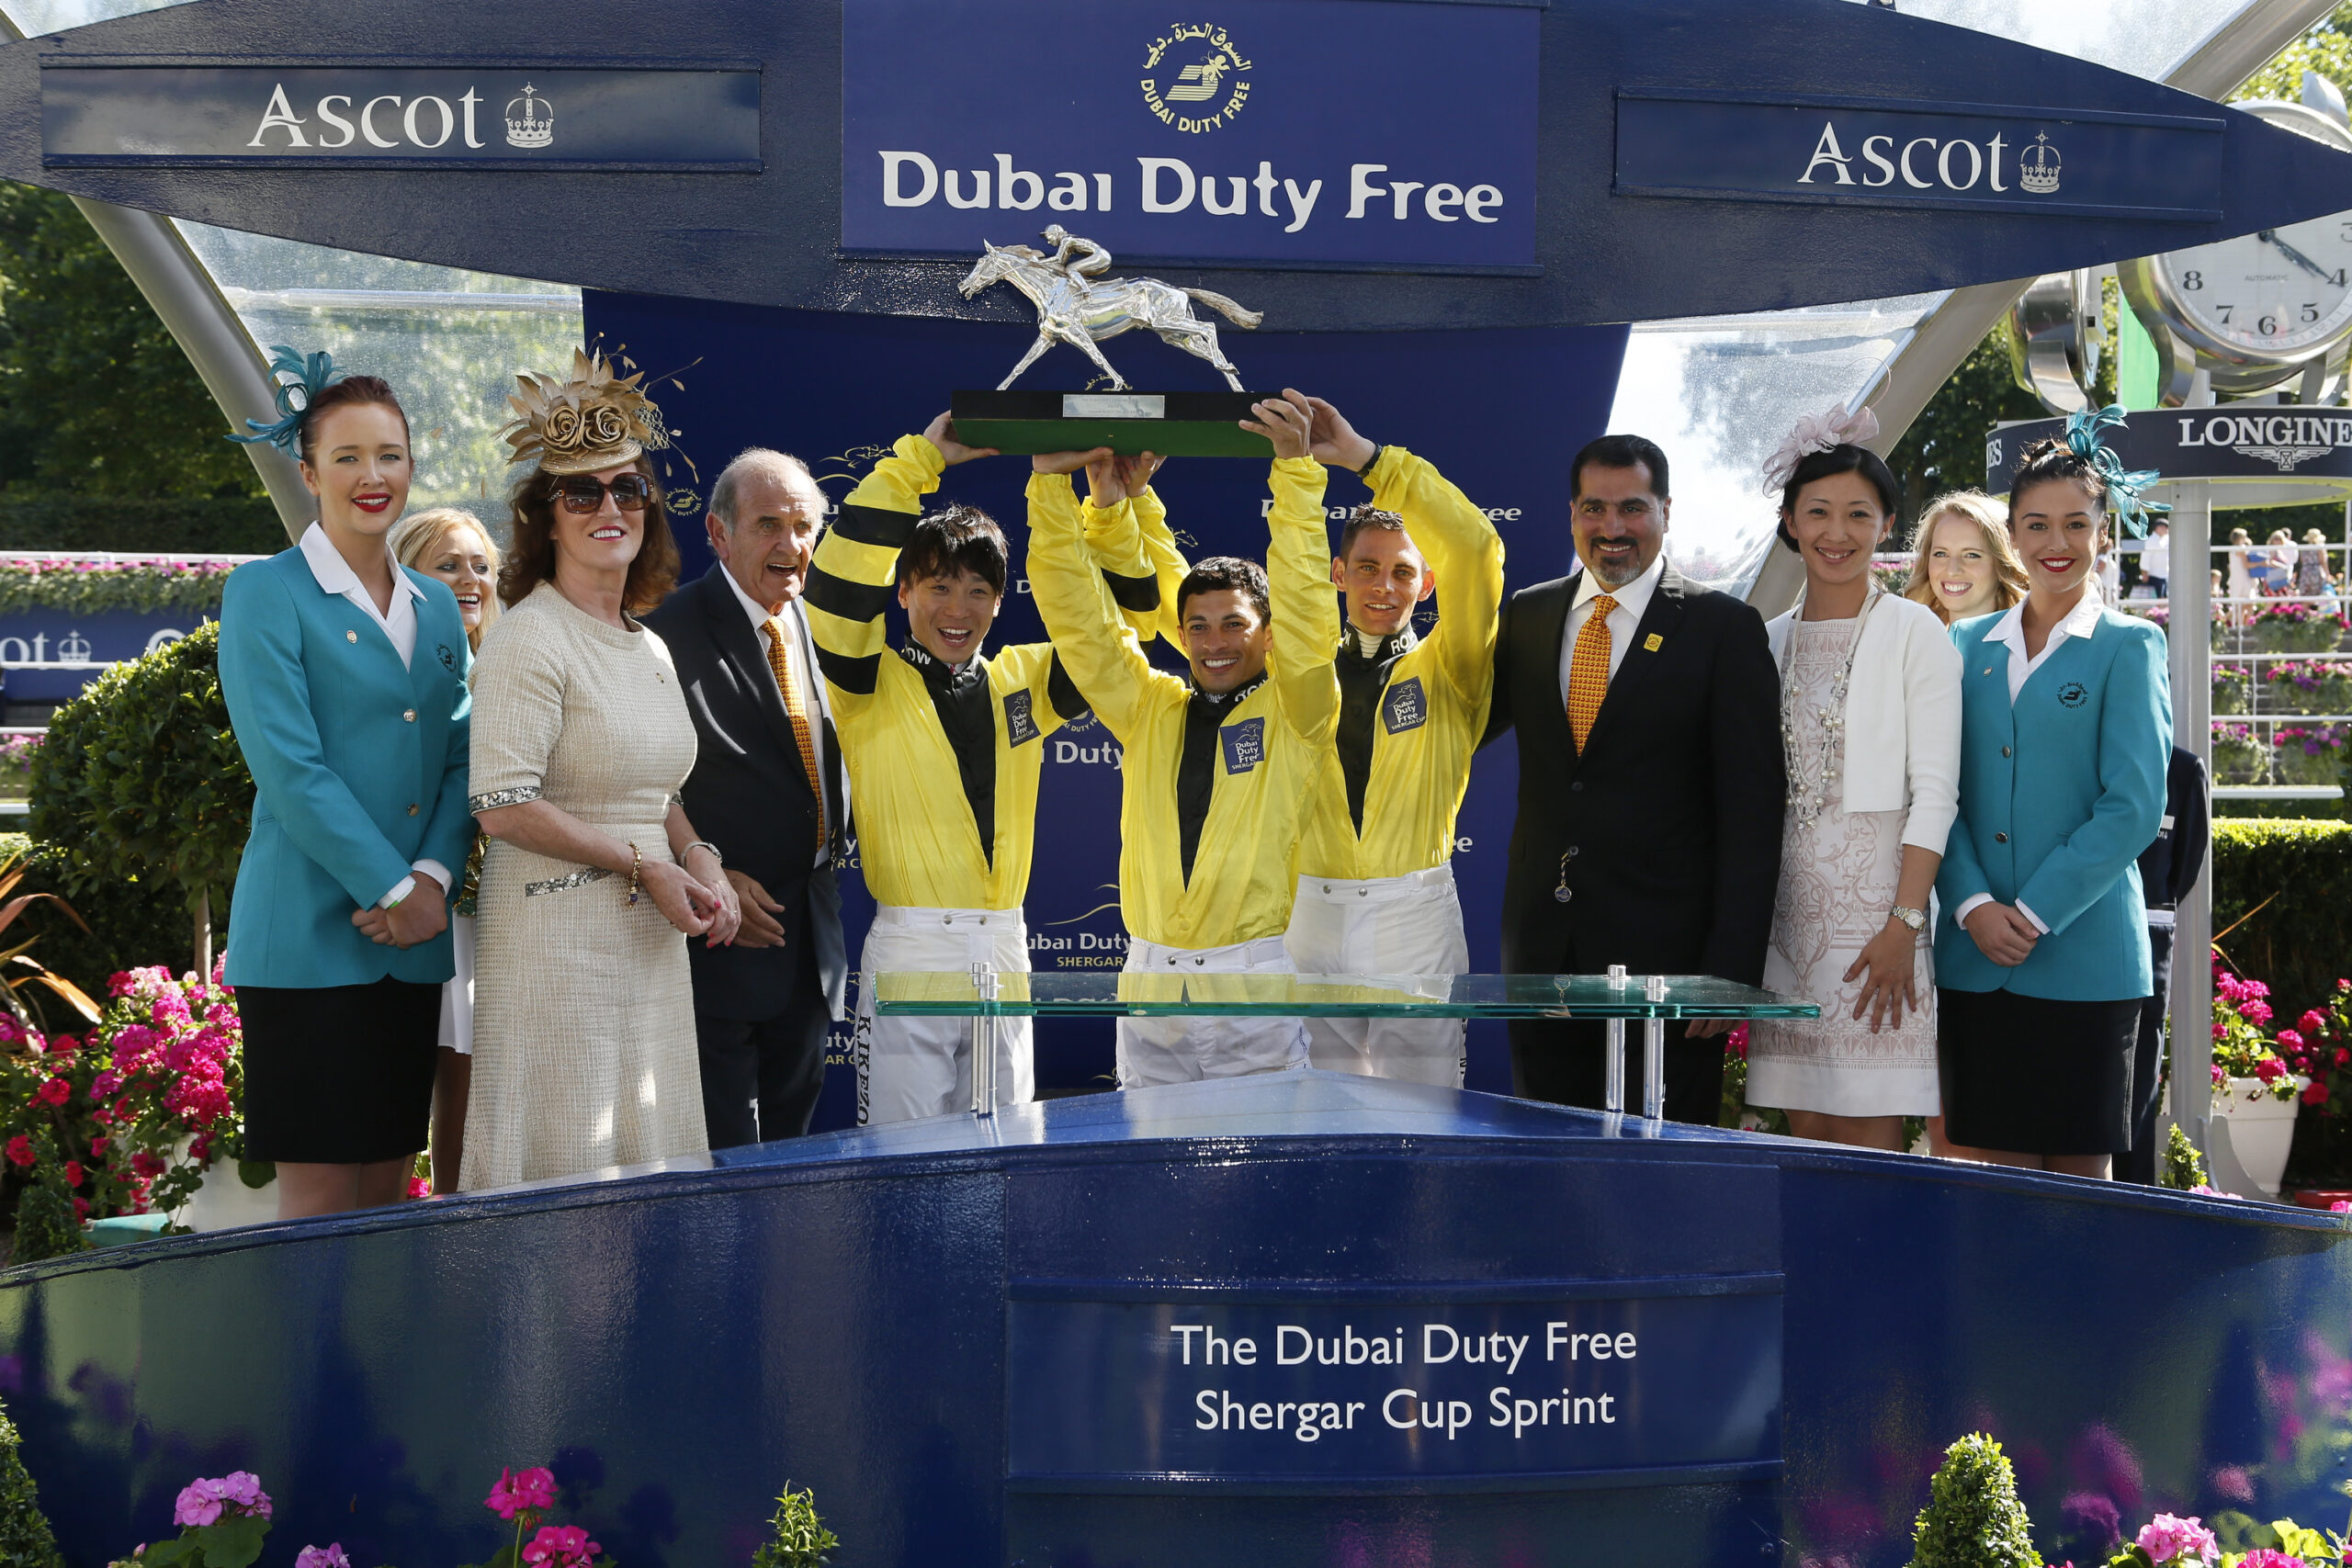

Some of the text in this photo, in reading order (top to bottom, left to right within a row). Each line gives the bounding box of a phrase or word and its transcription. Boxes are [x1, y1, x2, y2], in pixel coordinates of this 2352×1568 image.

[246, 84, 486, 149] Ascot
[1140, 79, 1250, 134] DUBAI DUTY FREE
[1797, 121, 2008, 192] Ascot
[878, 151, 1504, 233] Dubai Duty Free
[2183, 271, 2203, 290] 8
[2216, 305, 2234, 324] 7
[2301, 302, 2320, 322] 5
[2257, 316, 2277, 336] 6
[2179, 417, 2352, 446] LONGINE
[1395, 705, 1416, 717] Duty
[1396, 713, 1418, 724] Free
[1070, 724, 1090, 732] DUTY
[1055, 740, 1123, 770] Duty
[1236, 740, 1258, 750] Dubai
[1237, 746, 1259, 756] Duty
[1027, 933, 1131, 954] ubai Duty
[1057, 956, 1124, 967] SHERGAR
[1170, 1322, 1636, 1375] The Dubai Duty Free
[1196, 1386, 1615, 1442] Shergar Cup Sprint
